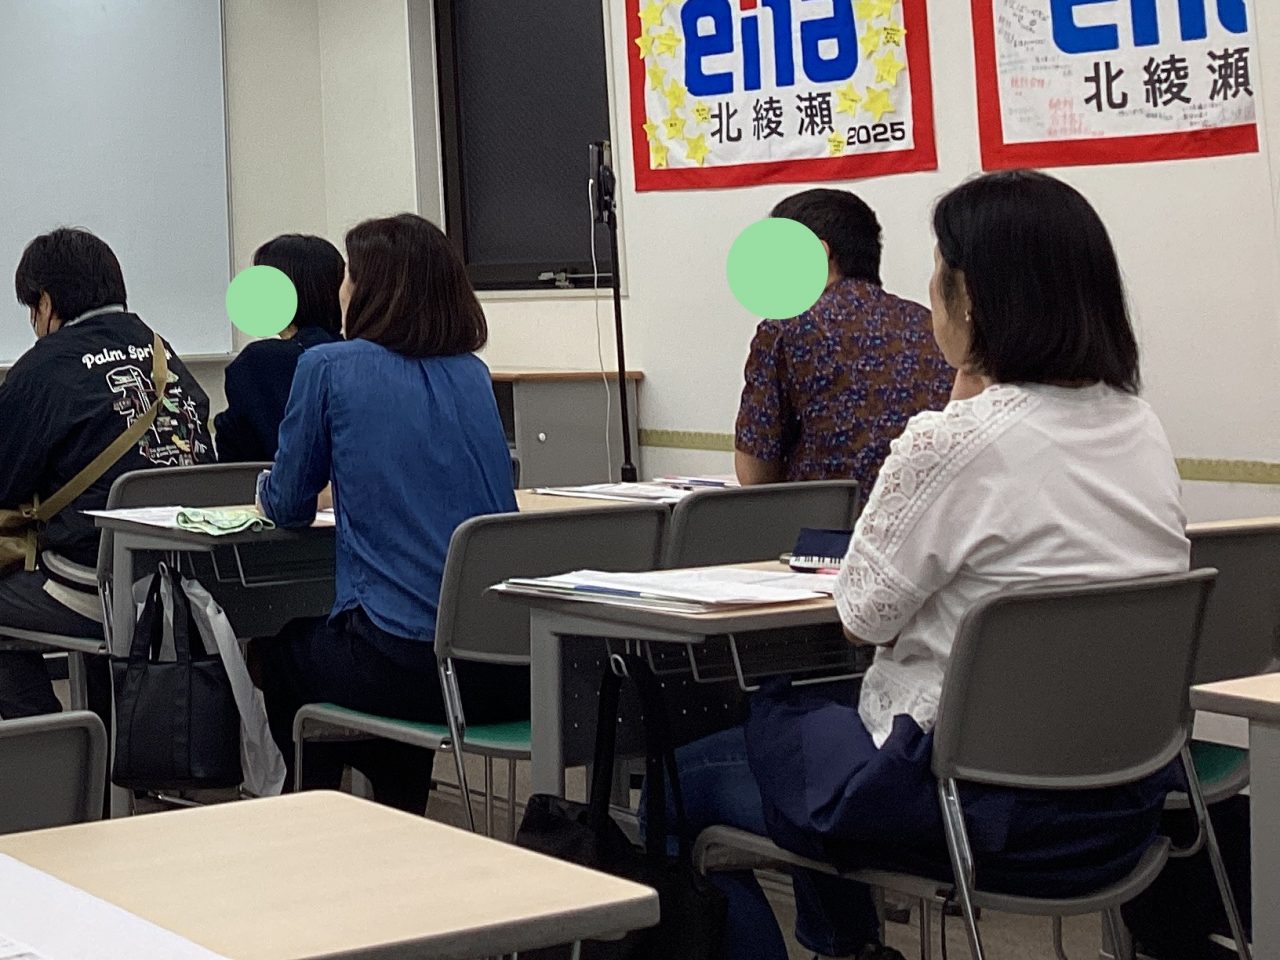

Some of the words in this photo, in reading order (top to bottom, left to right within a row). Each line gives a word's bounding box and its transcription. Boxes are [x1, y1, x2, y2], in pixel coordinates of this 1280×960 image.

[1084, 47, 1254, 113] 北綾瀬
[710, 92, 835, 144] 北綾瀬
[846, 121, 906, 147] 2025
[81, 347, 127, 370] Palm
